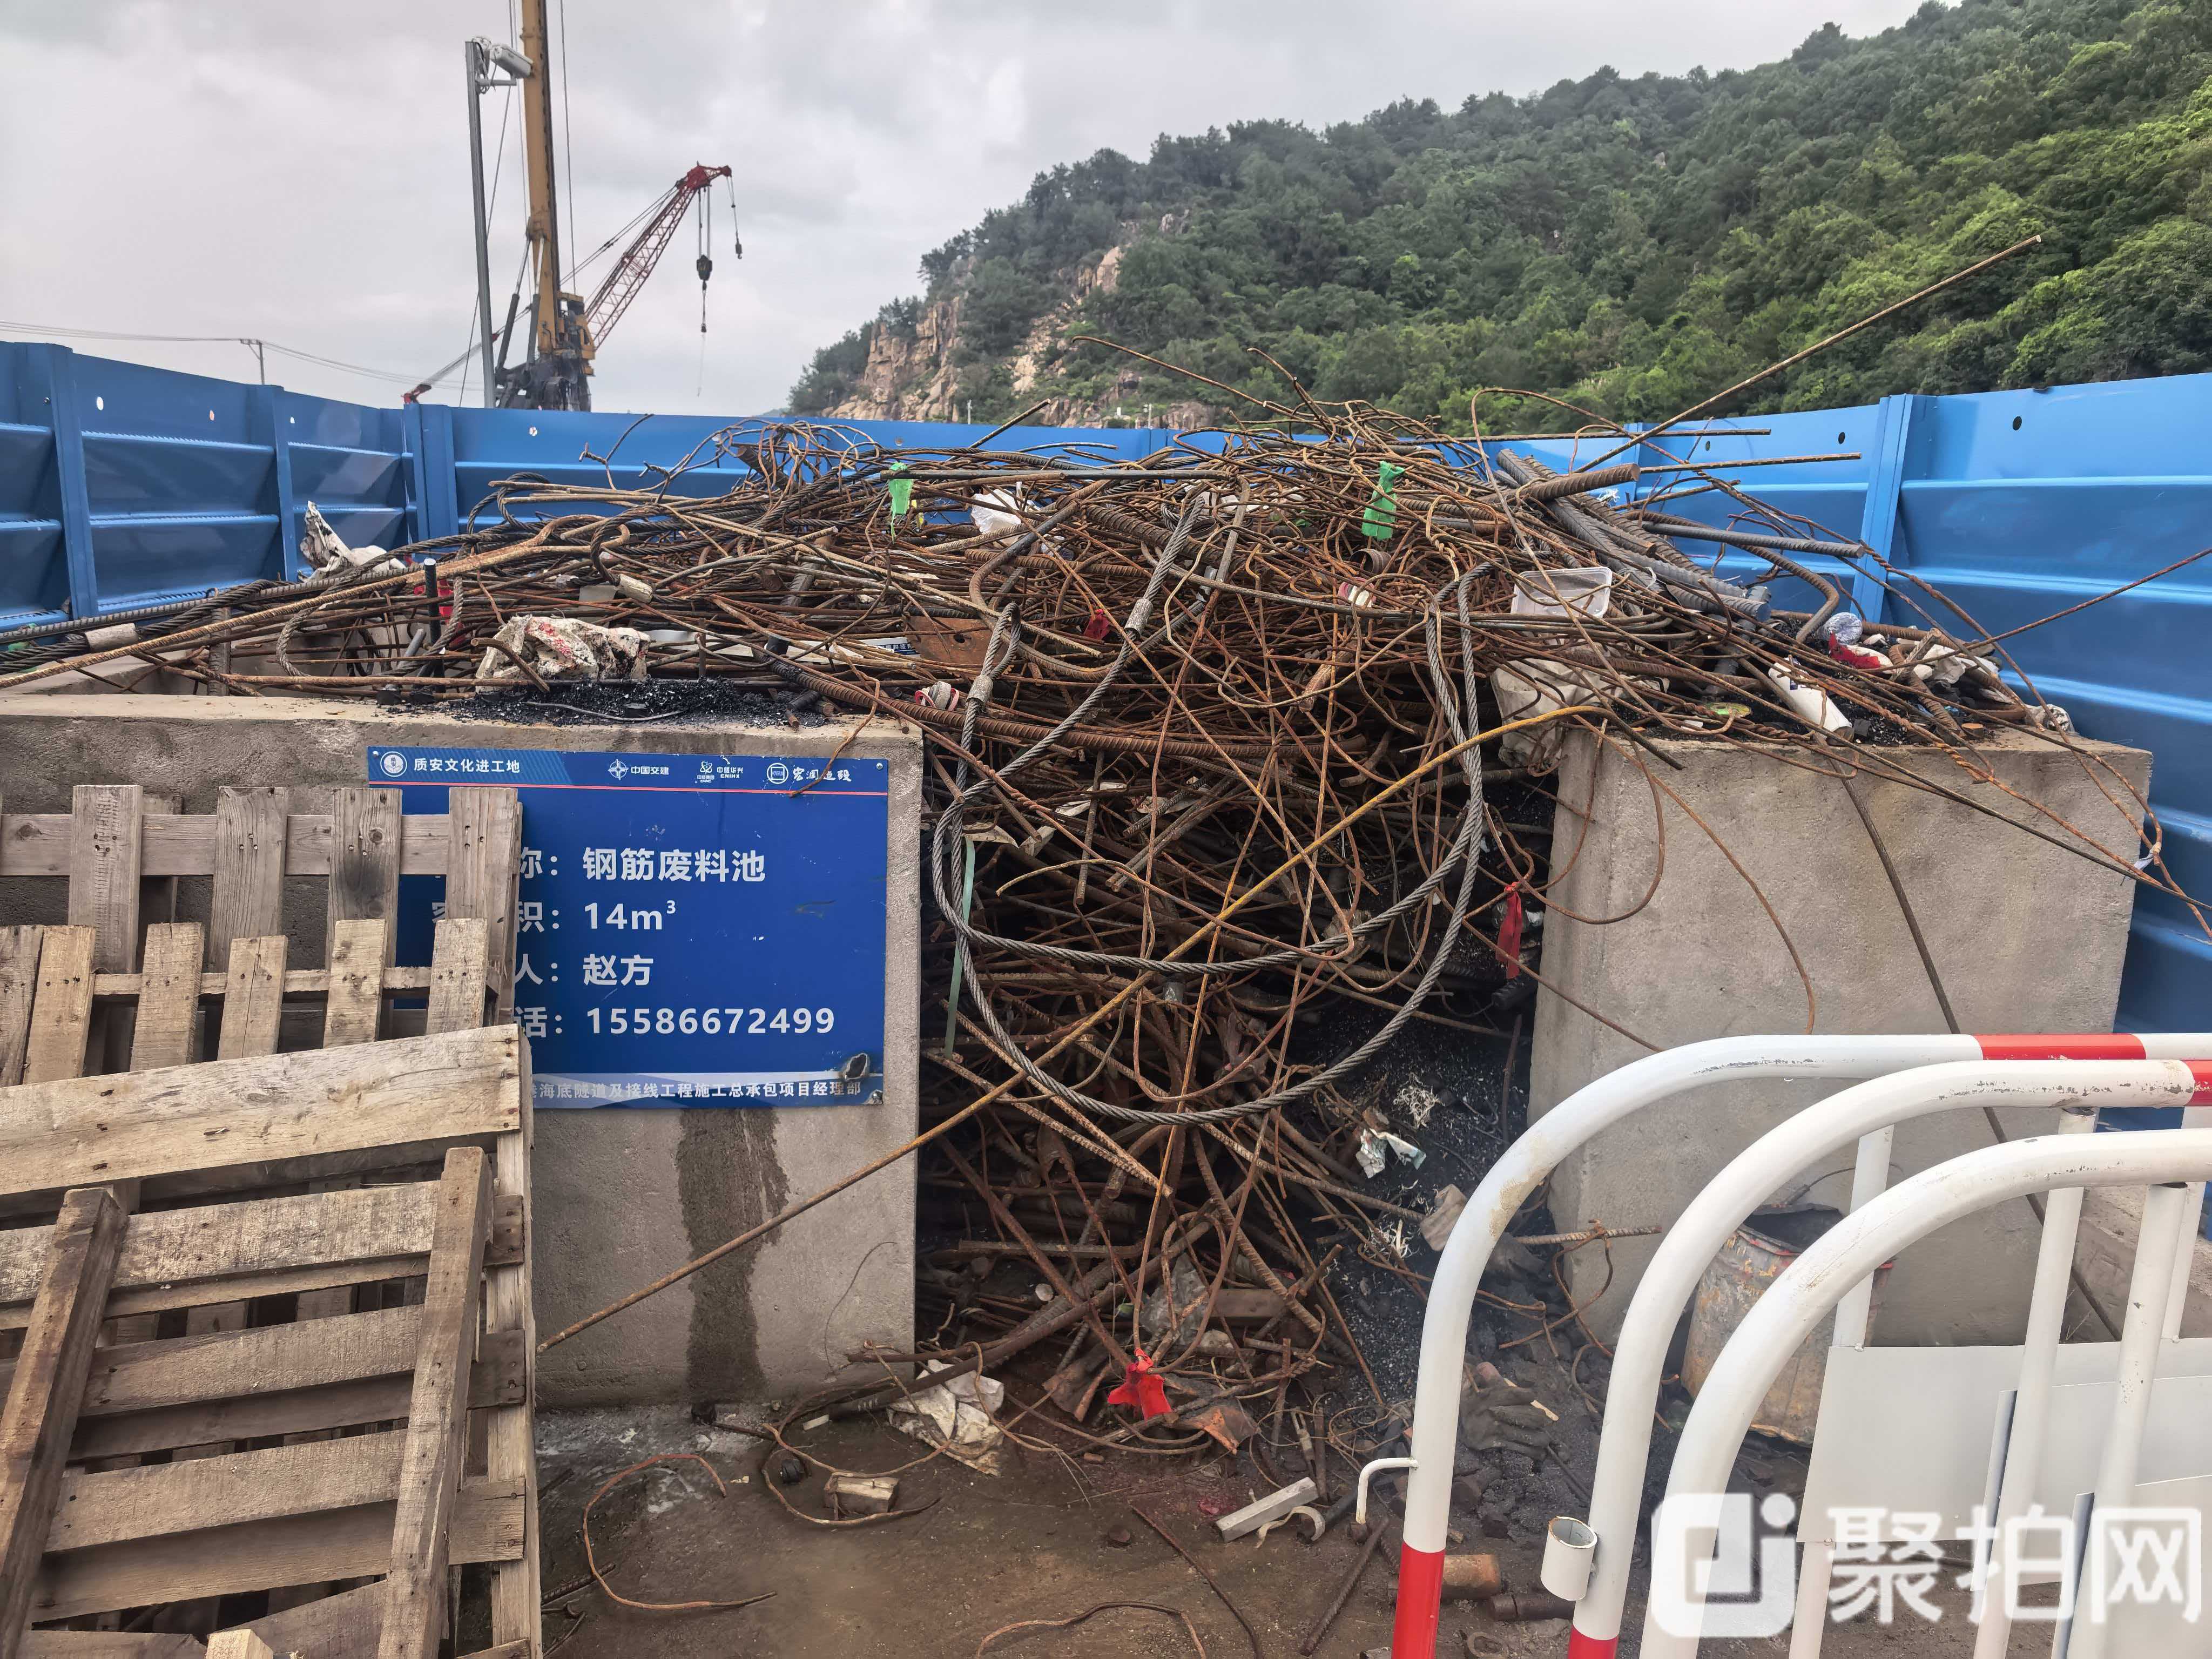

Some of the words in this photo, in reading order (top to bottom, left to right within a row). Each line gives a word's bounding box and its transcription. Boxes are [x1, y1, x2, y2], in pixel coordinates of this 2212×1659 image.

[414, 758, 520, 773] 质安文化进工地
[631, 766, 670, 775] 中国交建
